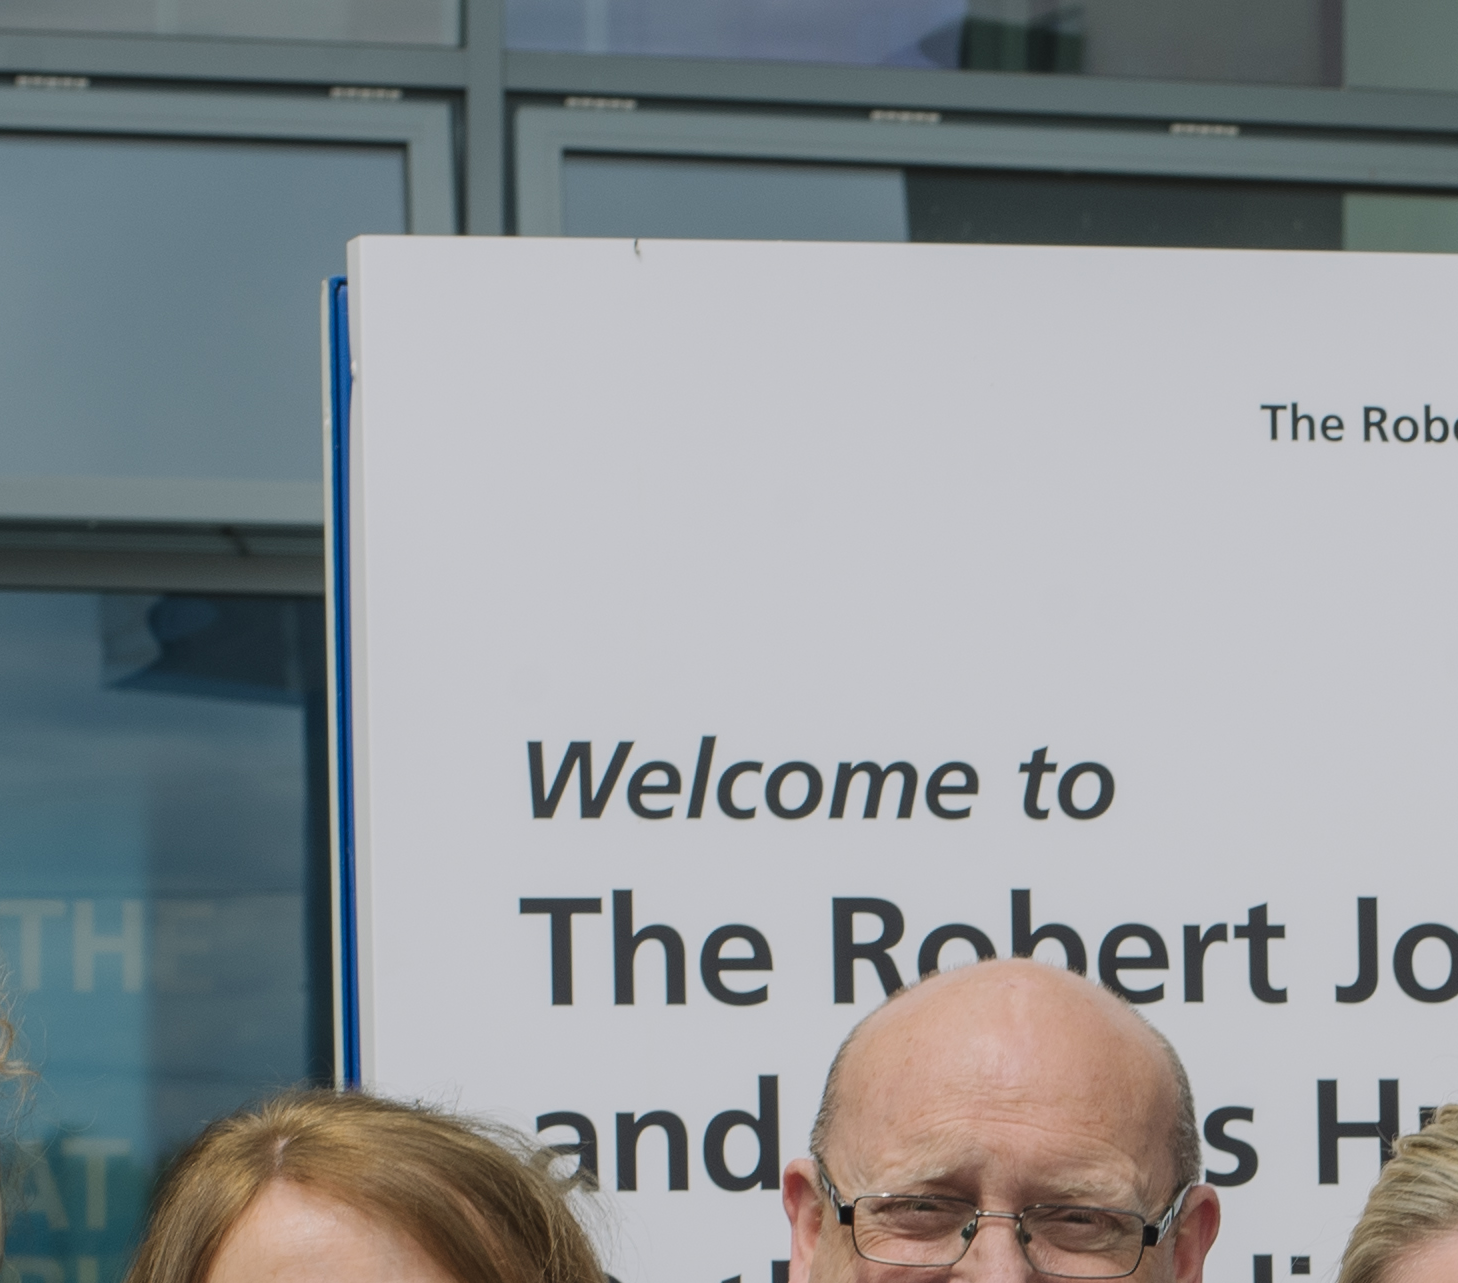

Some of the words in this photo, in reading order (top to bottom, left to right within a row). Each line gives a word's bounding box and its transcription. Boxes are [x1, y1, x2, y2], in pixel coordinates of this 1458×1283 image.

[1260, 402, 1344, 443] The
[526, 736, 980, 822] Welcome
[1018, 746, 1116, 821] to
[519, 889, 774, 1007] The
[534, 1074, 780, 1193] and
